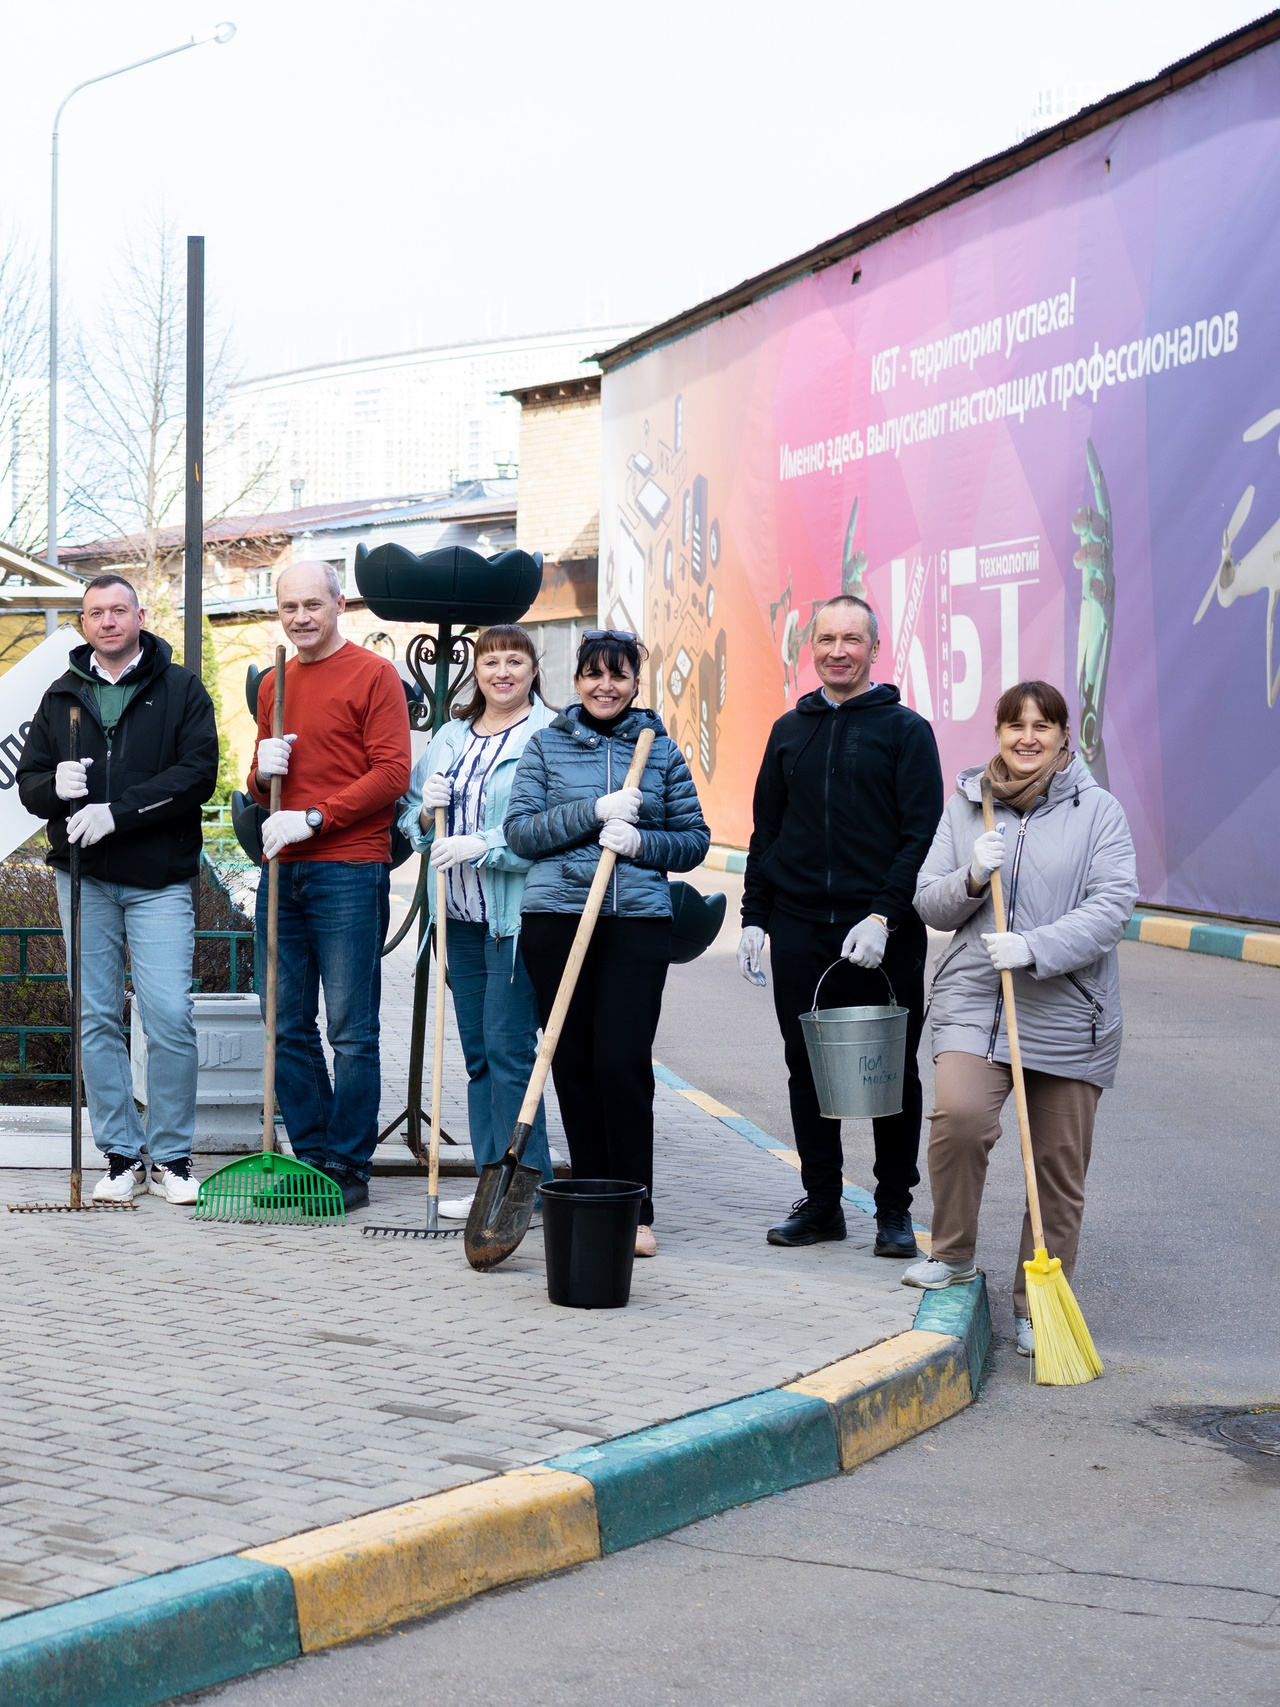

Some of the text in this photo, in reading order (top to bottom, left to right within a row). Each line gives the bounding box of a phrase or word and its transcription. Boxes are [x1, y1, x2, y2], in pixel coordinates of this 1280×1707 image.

[780, 311, 1238, 481] Именно здесь выпускают настоящих профессионалов
[871, 346, 900, 394] КБТ
[910, 317, 1003, 386] территория
[1006, 277, 1075, 359] успеха!
[891, 540, 1040, 721] КБТ
[893, 556, 925, 686] колледж
[940, 549, 949, 718] бизнес
[979, 542, 1040, 579] технологий
